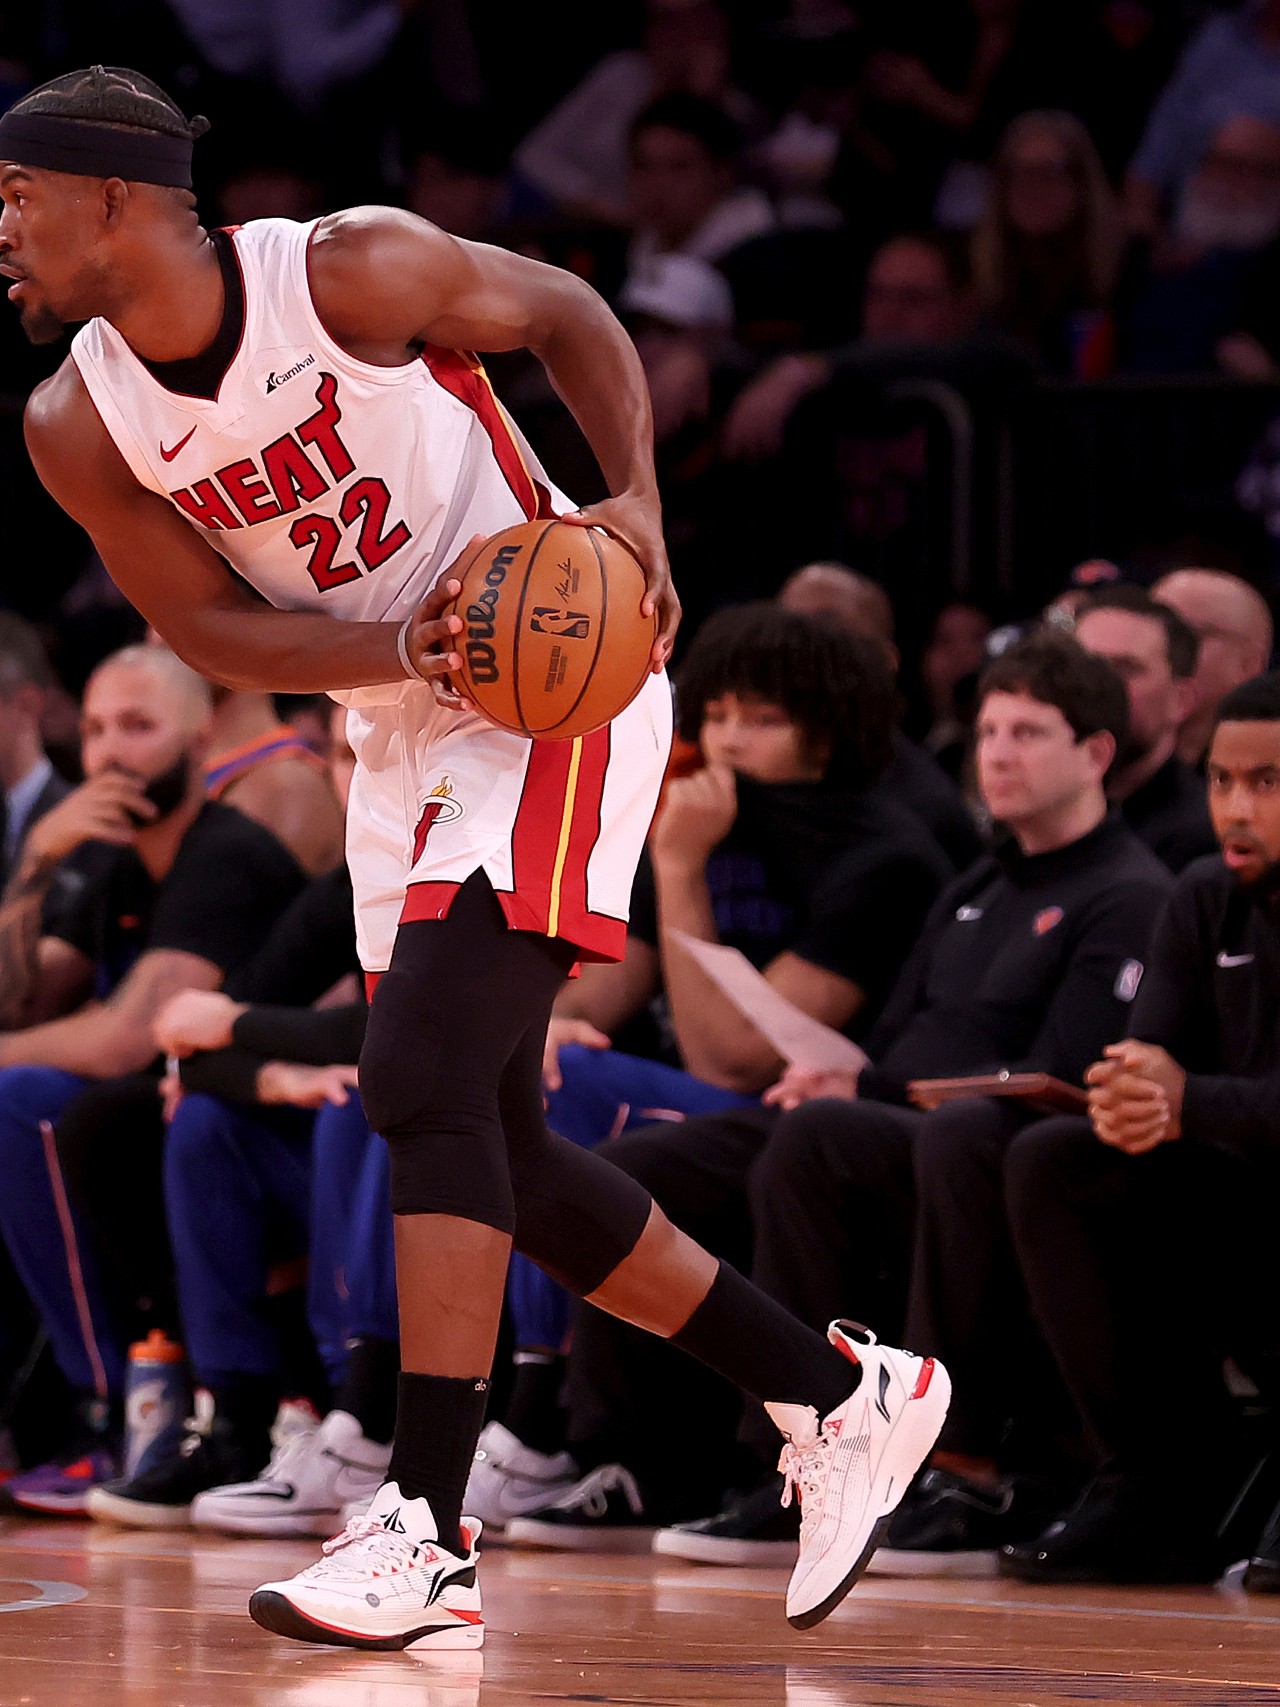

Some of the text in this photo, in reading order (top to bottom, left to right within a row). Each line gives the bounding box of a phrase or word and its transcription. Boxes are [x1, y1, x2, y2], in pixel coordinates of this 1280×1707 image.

[275, 353, 316, 386] Carnival
[169, 371, 357, 531] HEAT
[288, 477, 413, 594] 22
[465, 544, 523, 686] Wilson
